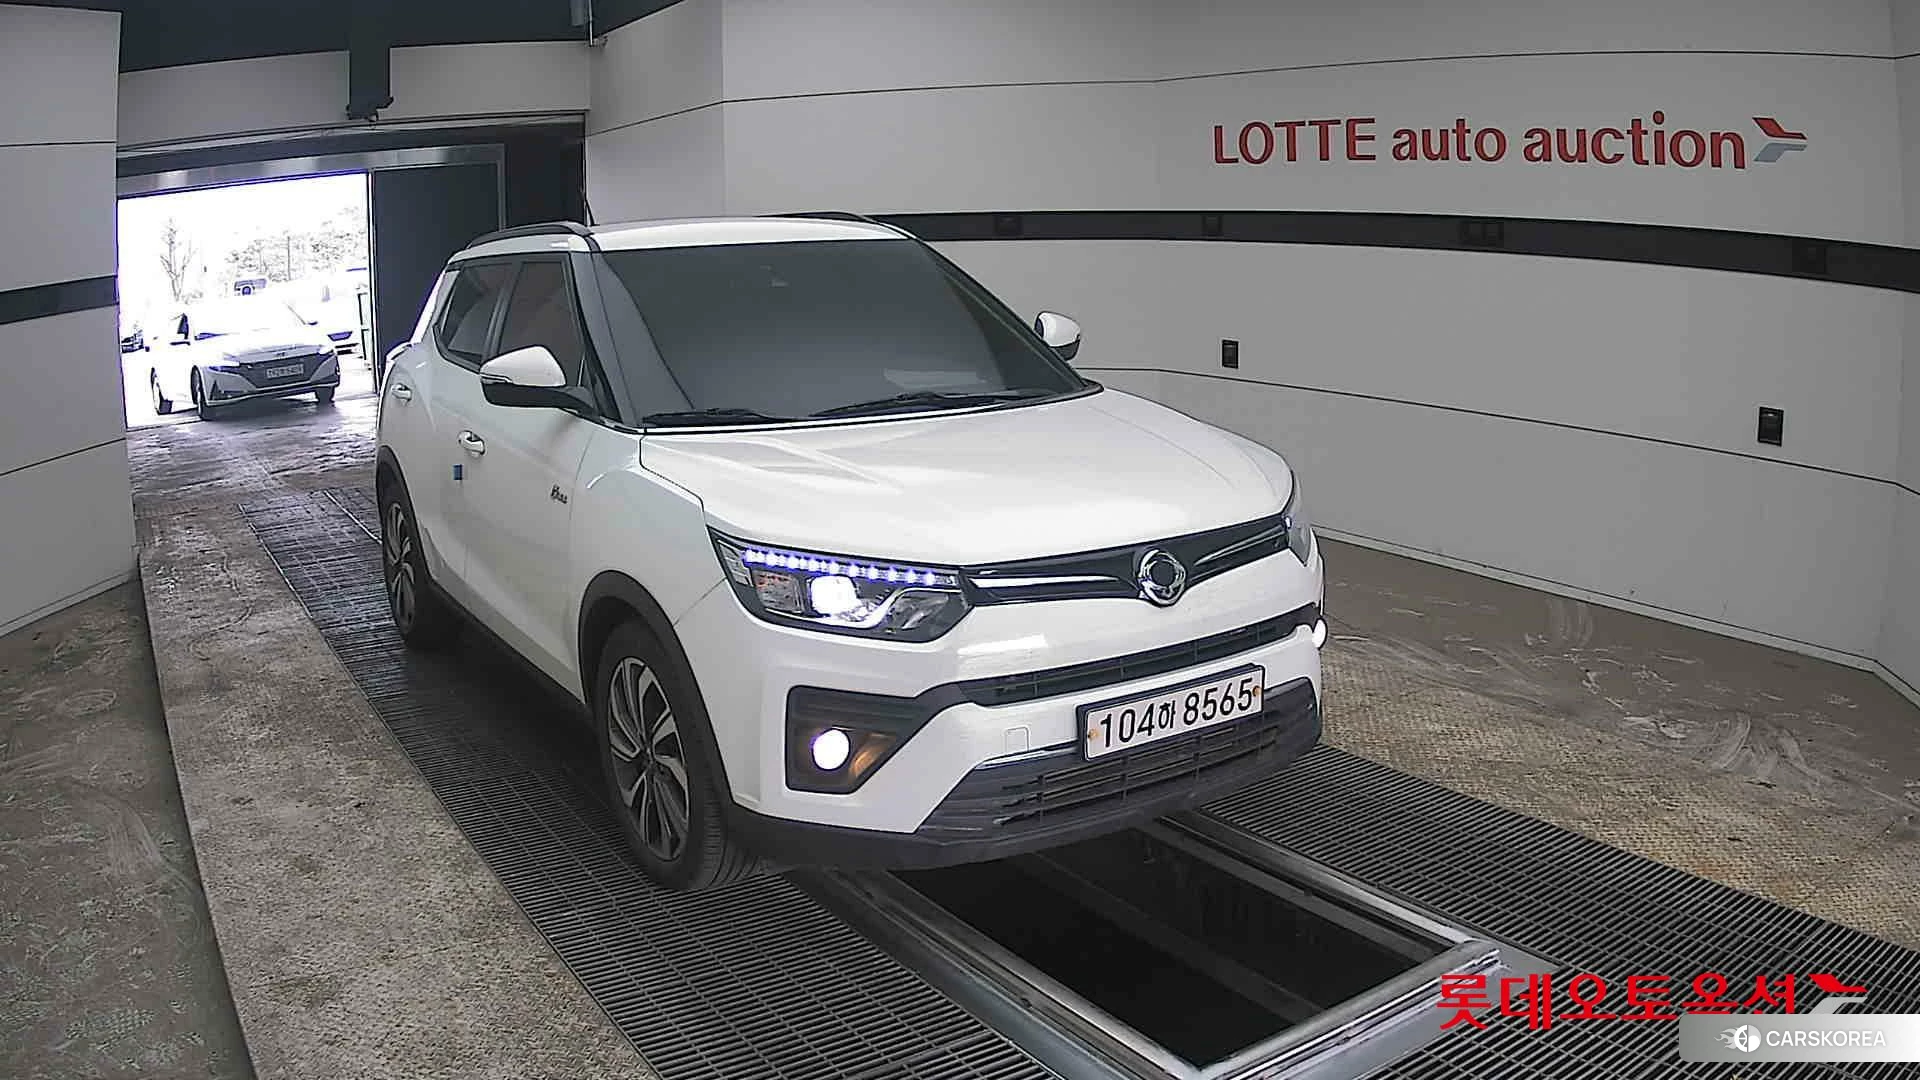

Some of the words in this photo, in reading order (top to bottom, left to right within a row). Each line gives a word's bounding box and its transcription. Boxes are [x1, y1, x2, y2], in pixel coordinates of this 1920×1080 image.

[1213, 118, 1377, 165] LOTTE
[1392, 118, 1507, 163] auto
[1523, 110, 1746, 169] auction
[1100, 700, 1176, 747] 104하
[1183, 678, 1253, 726] 8565
